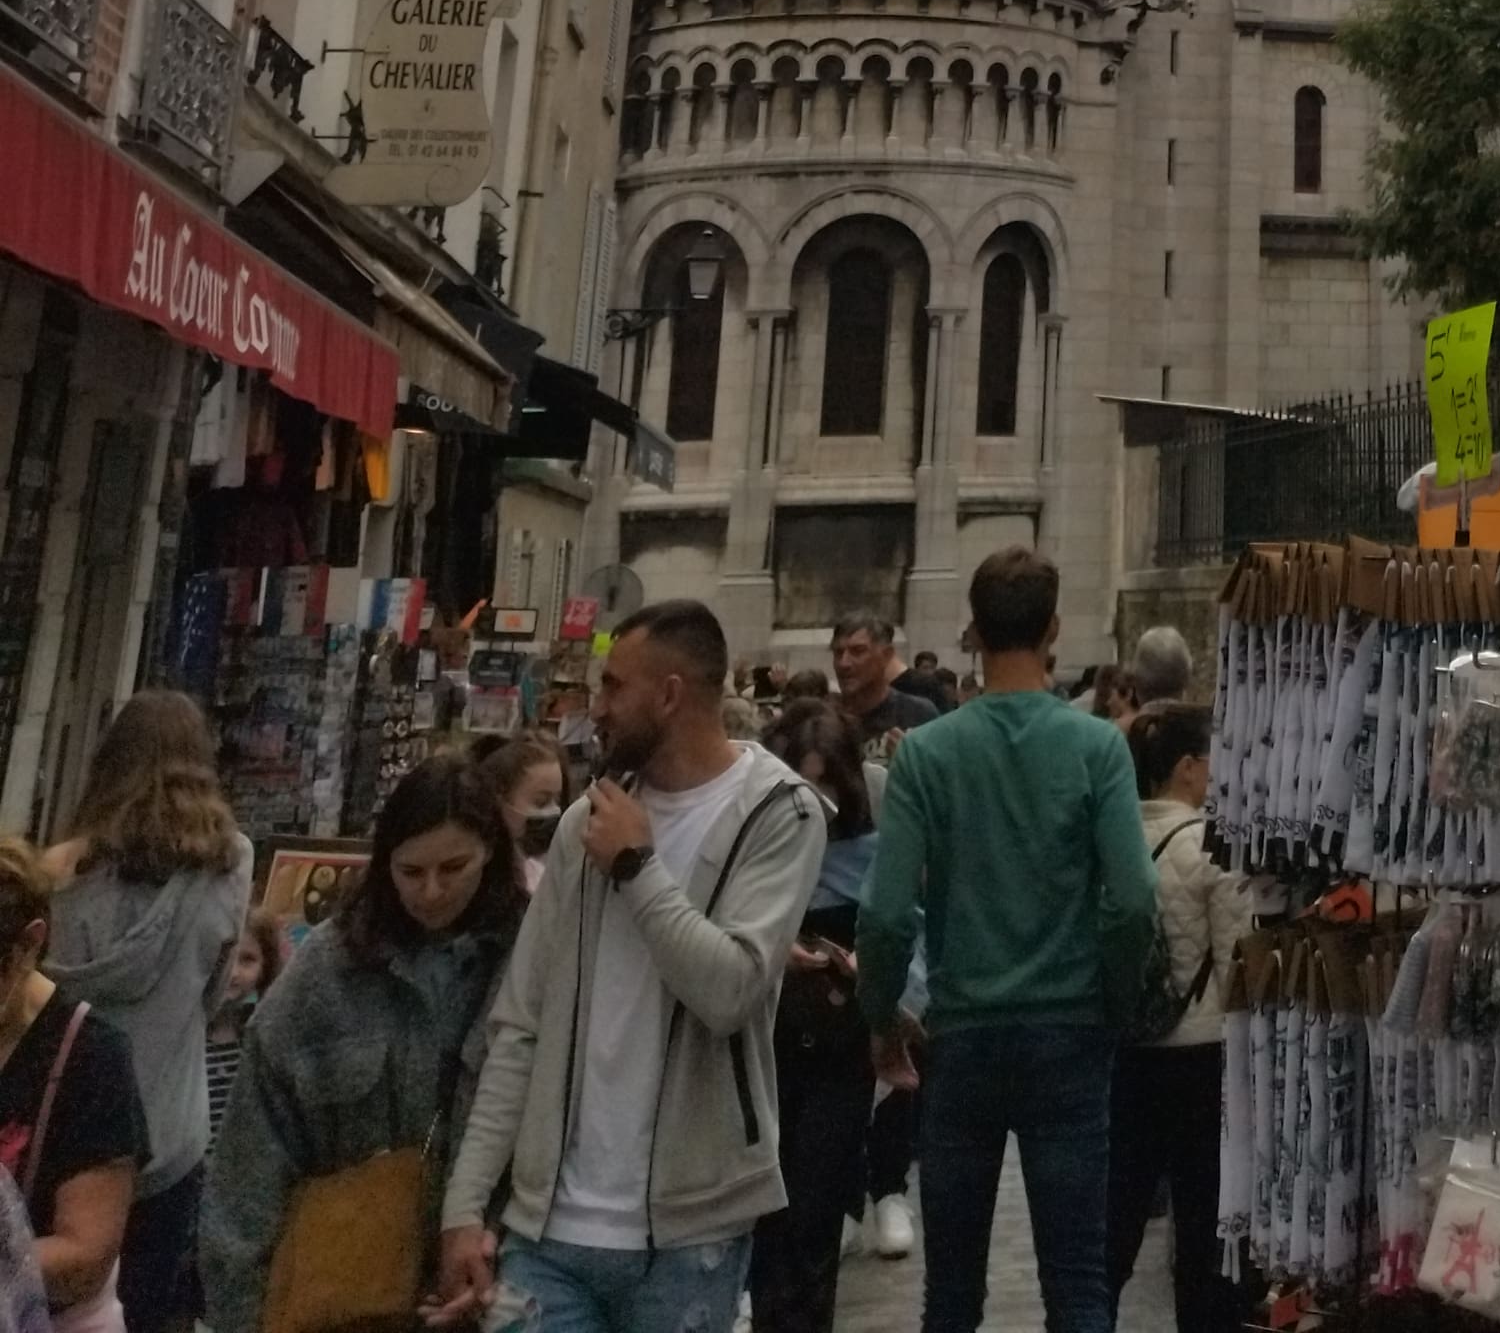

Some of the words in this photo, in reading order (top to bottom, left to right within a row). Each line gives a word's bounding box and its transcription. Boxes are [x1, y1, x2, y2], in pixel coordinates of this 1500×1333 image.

[419, 34, 438, 53] DU
[370, 60, 476, 91] CHEVALIER
[124, 190, 166, 309] Au
[170, 222, 228, 341] Coeur
